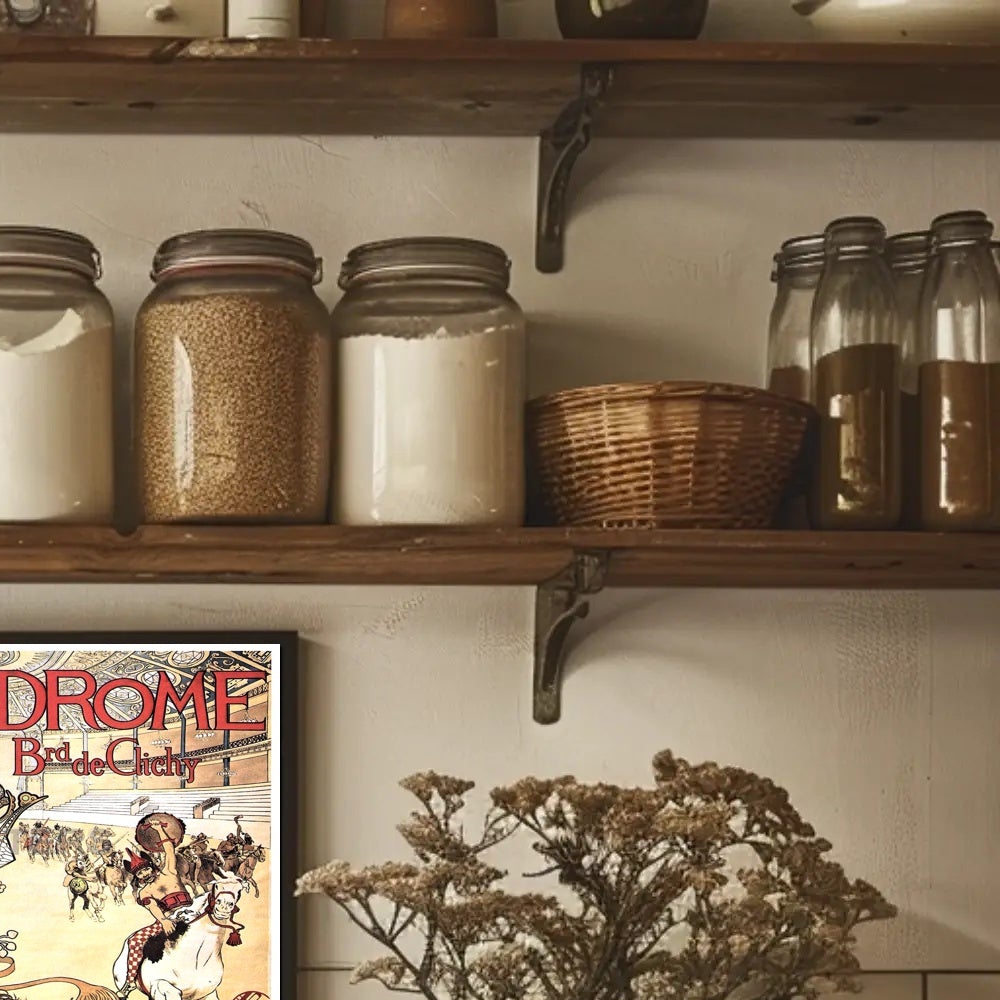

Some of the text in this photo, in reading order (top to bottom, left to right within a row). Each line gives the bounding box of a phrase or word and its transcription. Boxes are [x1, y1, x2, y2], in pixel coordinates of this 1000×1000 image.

[12, 737, 201, 783] Brd de Clichy
